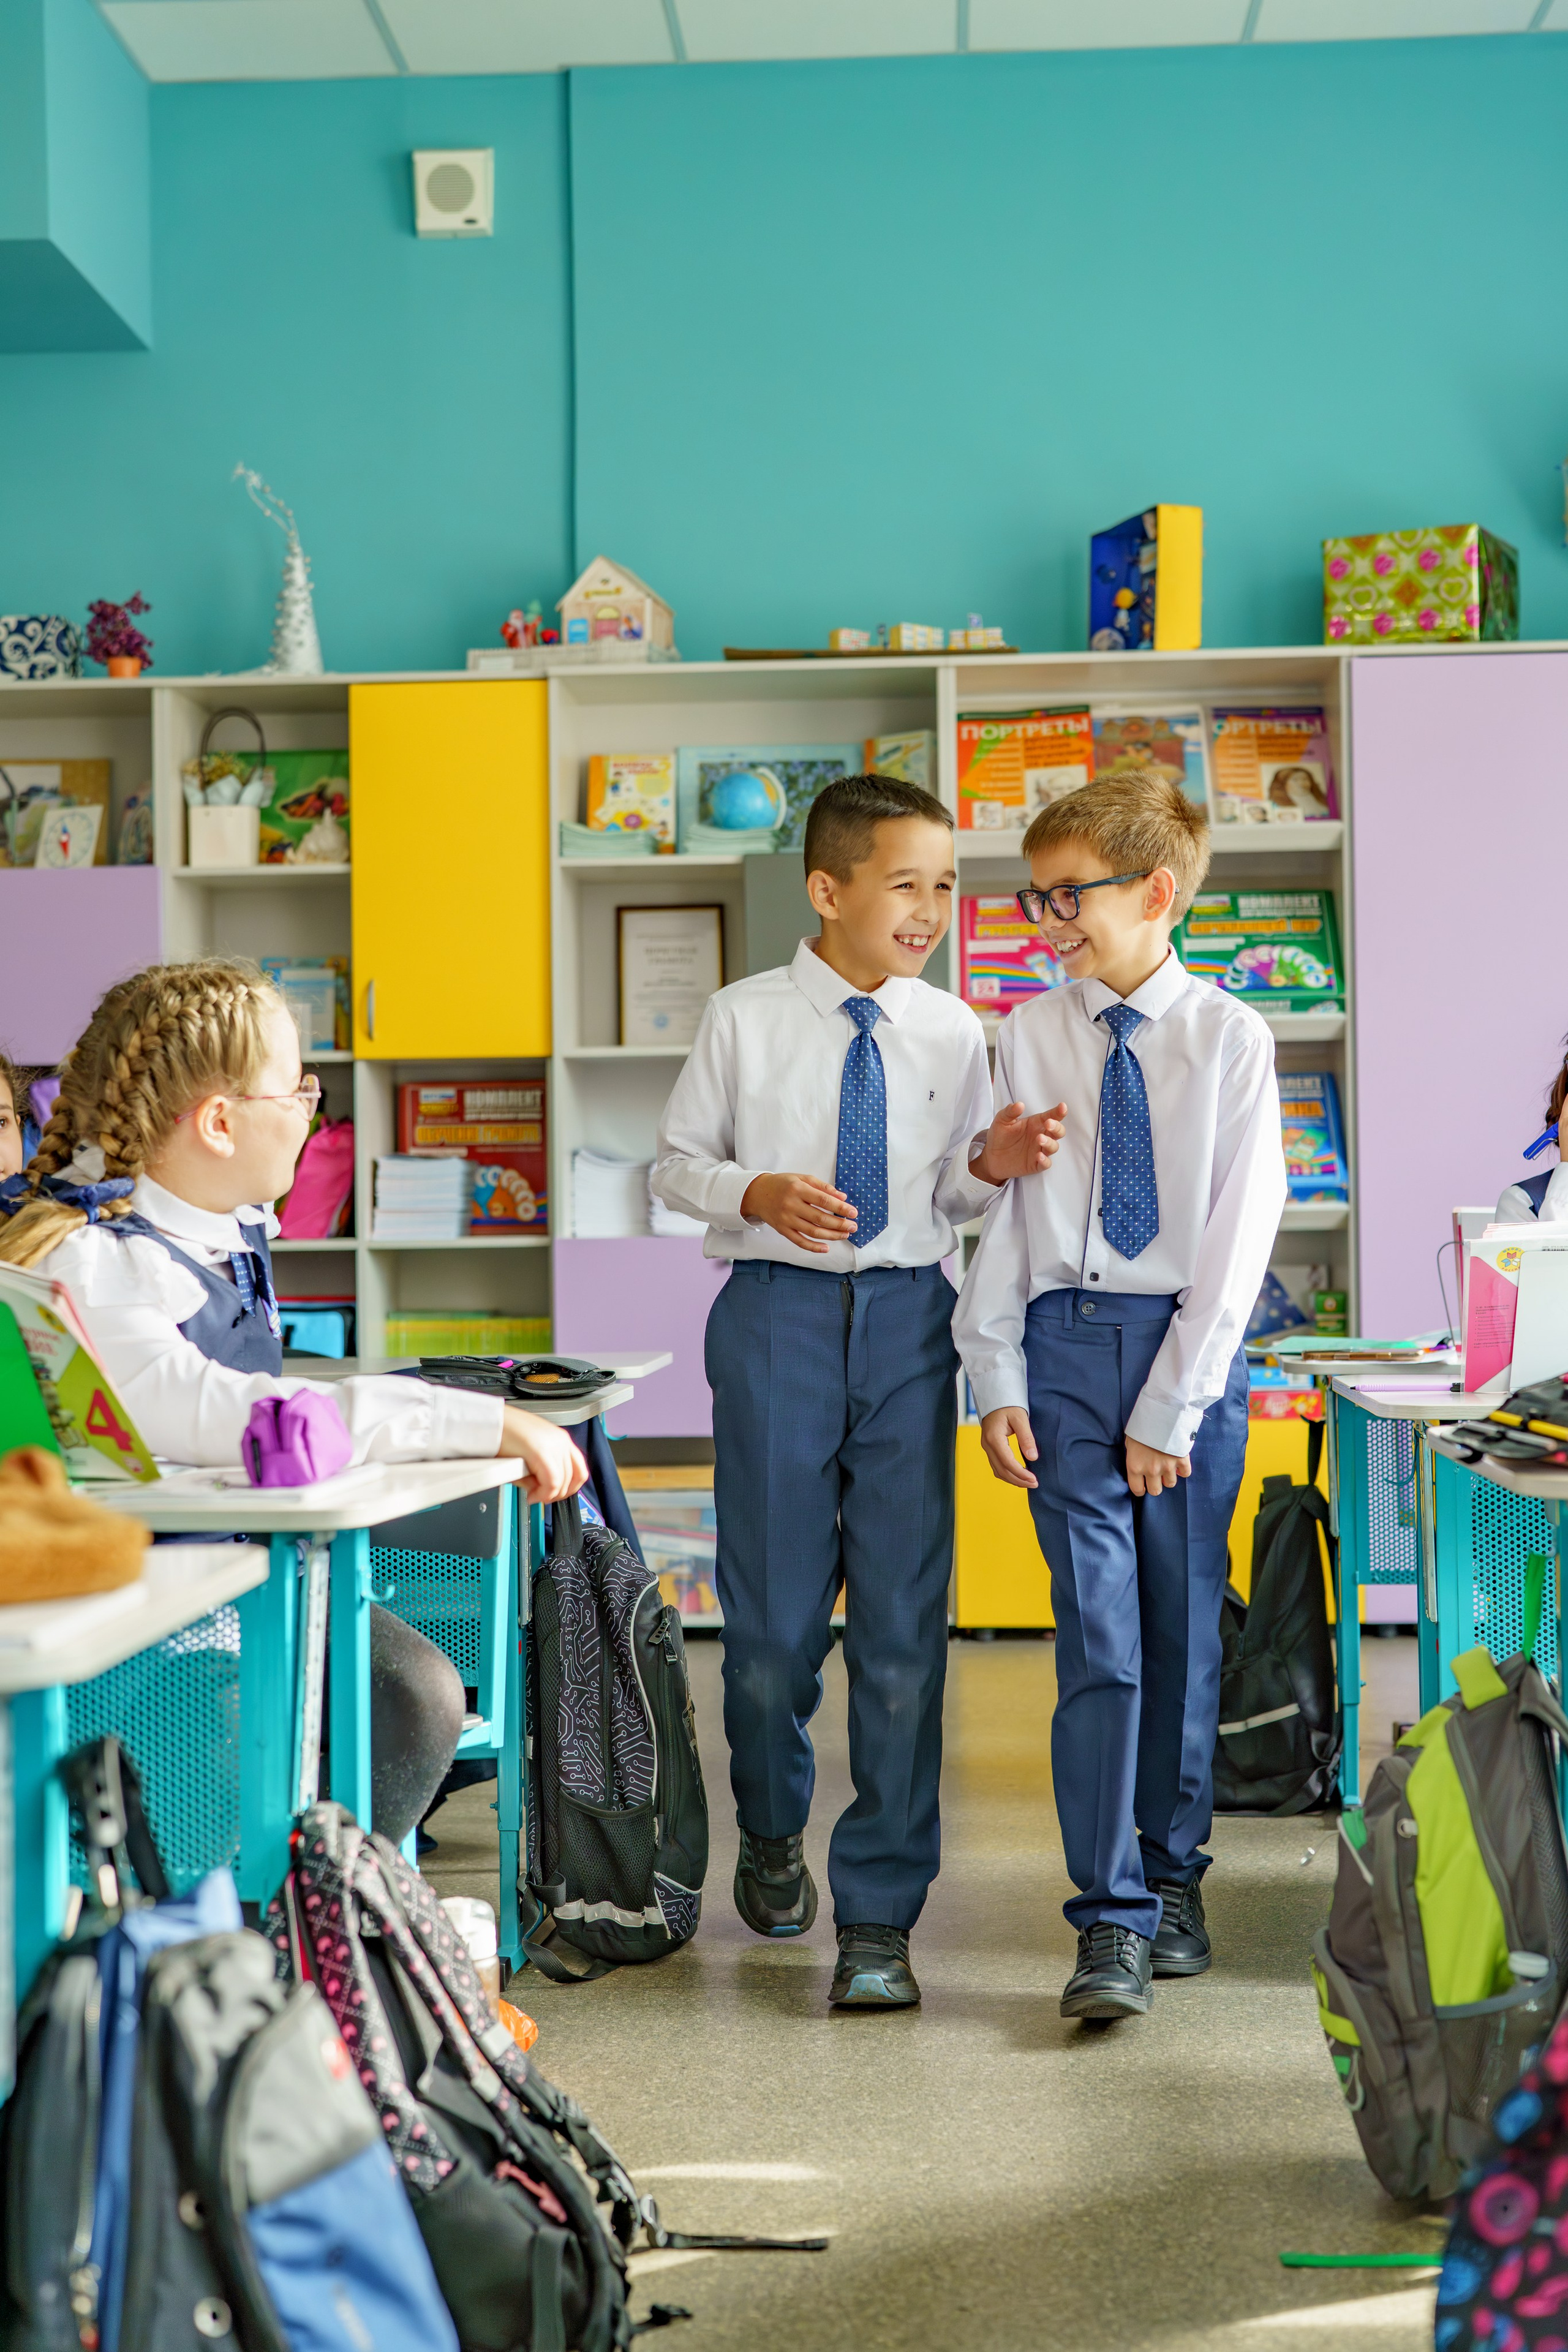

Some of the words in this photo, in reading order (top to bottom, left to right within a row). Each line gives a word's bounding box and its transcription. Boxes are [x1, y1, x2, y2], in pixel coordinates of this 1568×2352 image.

[961, 718, 1089, 741] ПОРТРЕТЫ
[1213, 718, 1322, 735] ОРТРЕТЫ
[929, 1091, 935, 1101] F
[86, 1389, 134, 1452] 4
